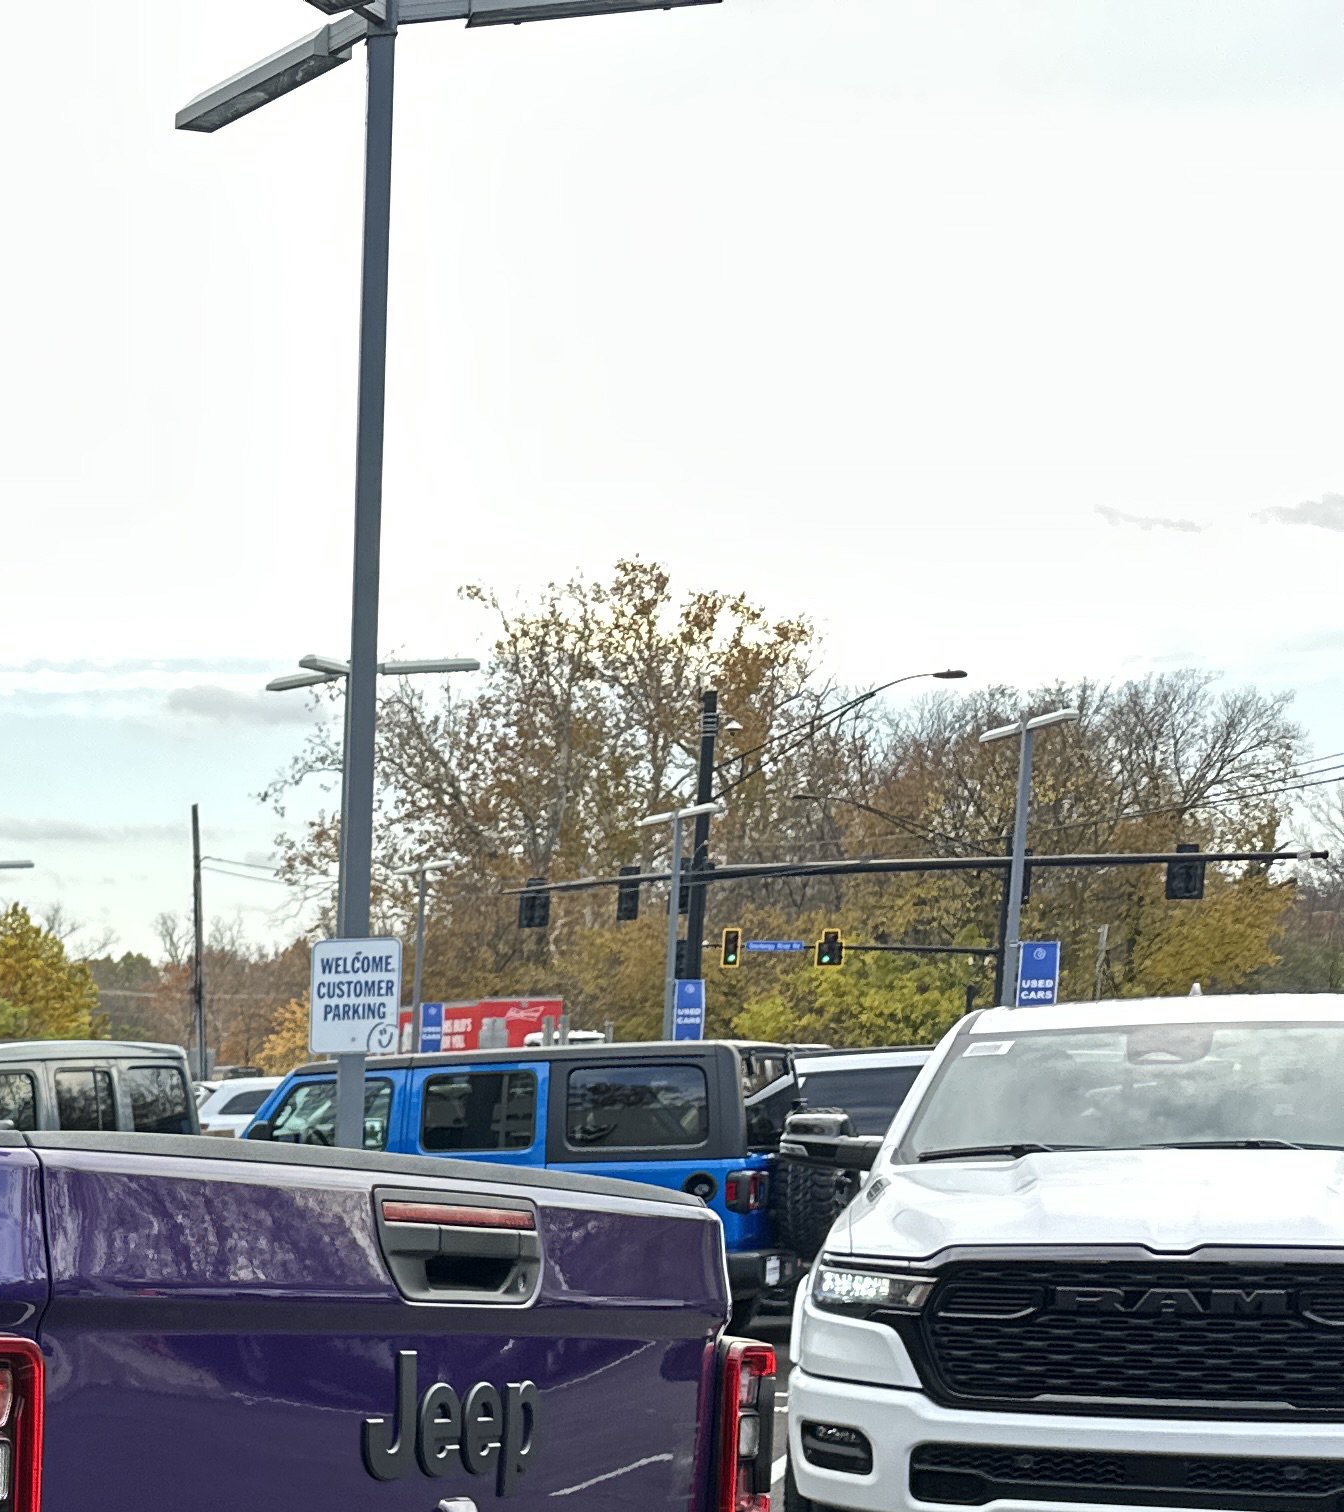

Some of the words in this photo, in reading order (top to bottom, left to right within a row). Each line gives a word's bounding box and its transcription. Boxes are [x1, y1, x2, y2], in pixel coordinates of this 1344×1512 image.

[321, 955, 393, 975] WELCOME
[317, 980, 395, 999] CUSTOMER
[1022, 979, 1054, 988] USED
[1021, 990, 1053, 999] CARS
[324, 1002, 386, 1021] PARKING
[676, 1016, 701, 1024] CARS
[677, 1007, 702, 1015] USED
[1054, 1286, 1289, 1314] RAM
[360, 1350, 540, 1497] Jeep
